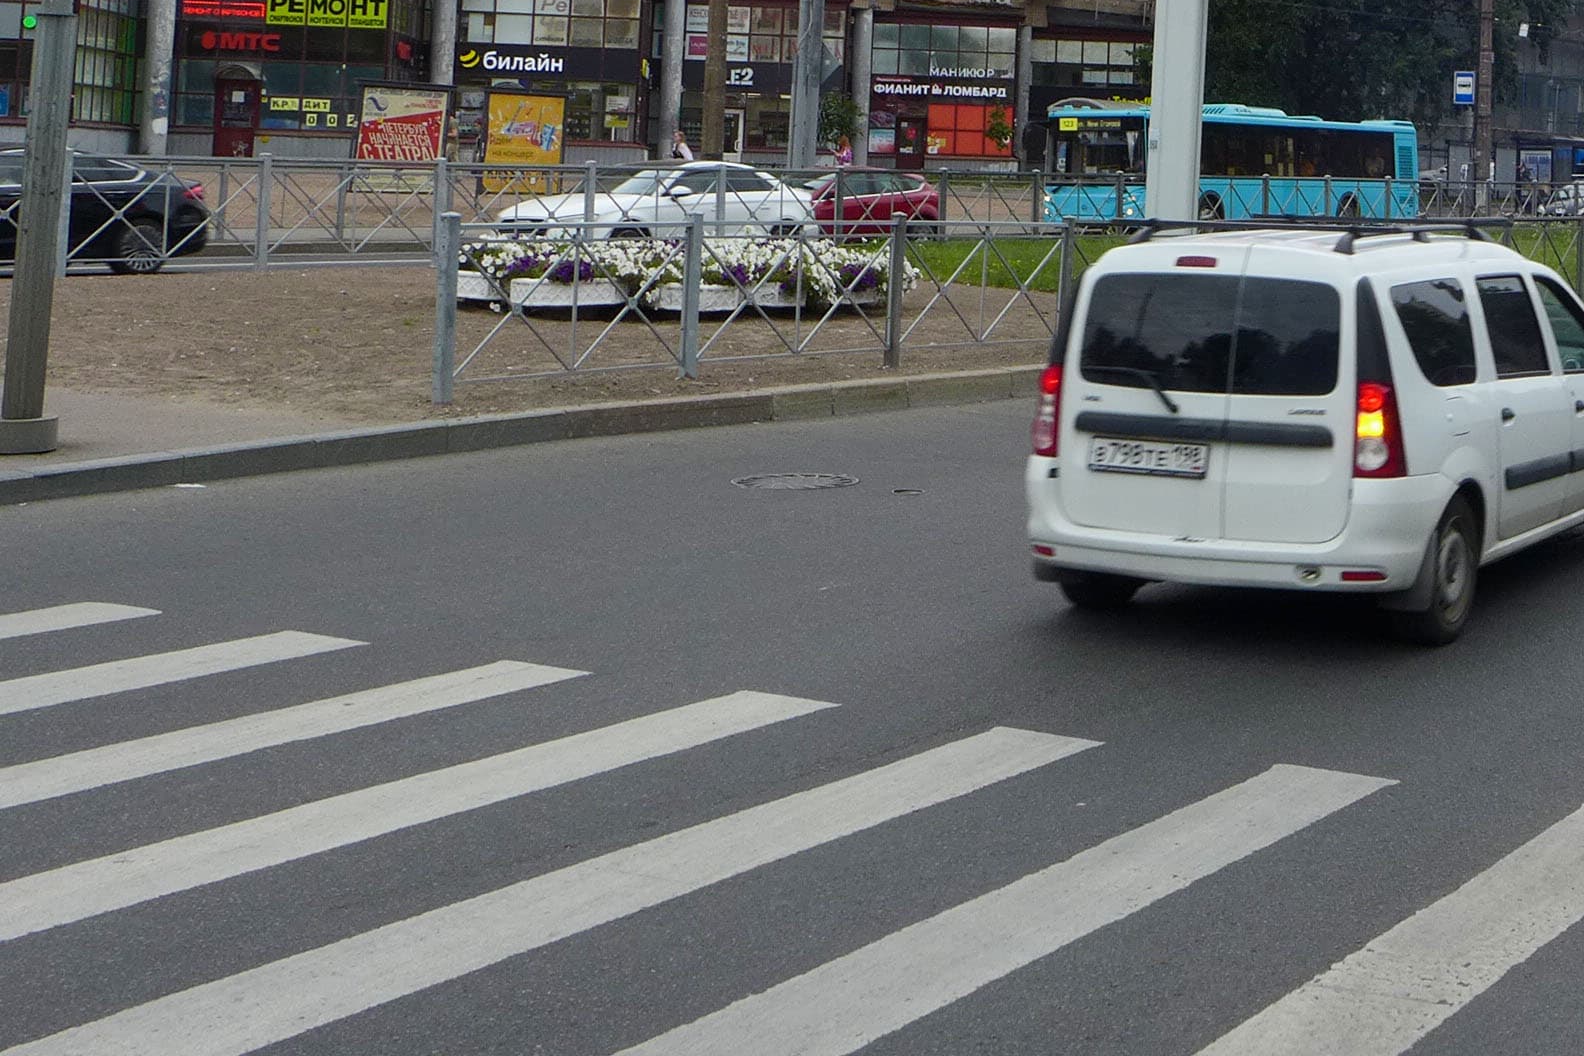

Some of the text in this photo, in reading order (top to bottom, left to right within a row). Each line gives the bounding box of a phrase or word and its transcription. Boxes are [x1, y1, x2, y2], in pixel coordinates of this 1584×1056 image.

[220, 33, 282, 51] МТС
[483, 51, 564, 72] билайн
[929, 66, 995, 79] МАНИКЮР
[874, 84, 1007, 98] ФИАНИТ ЛОМБАРД
[363, 145, 374, 160] С
